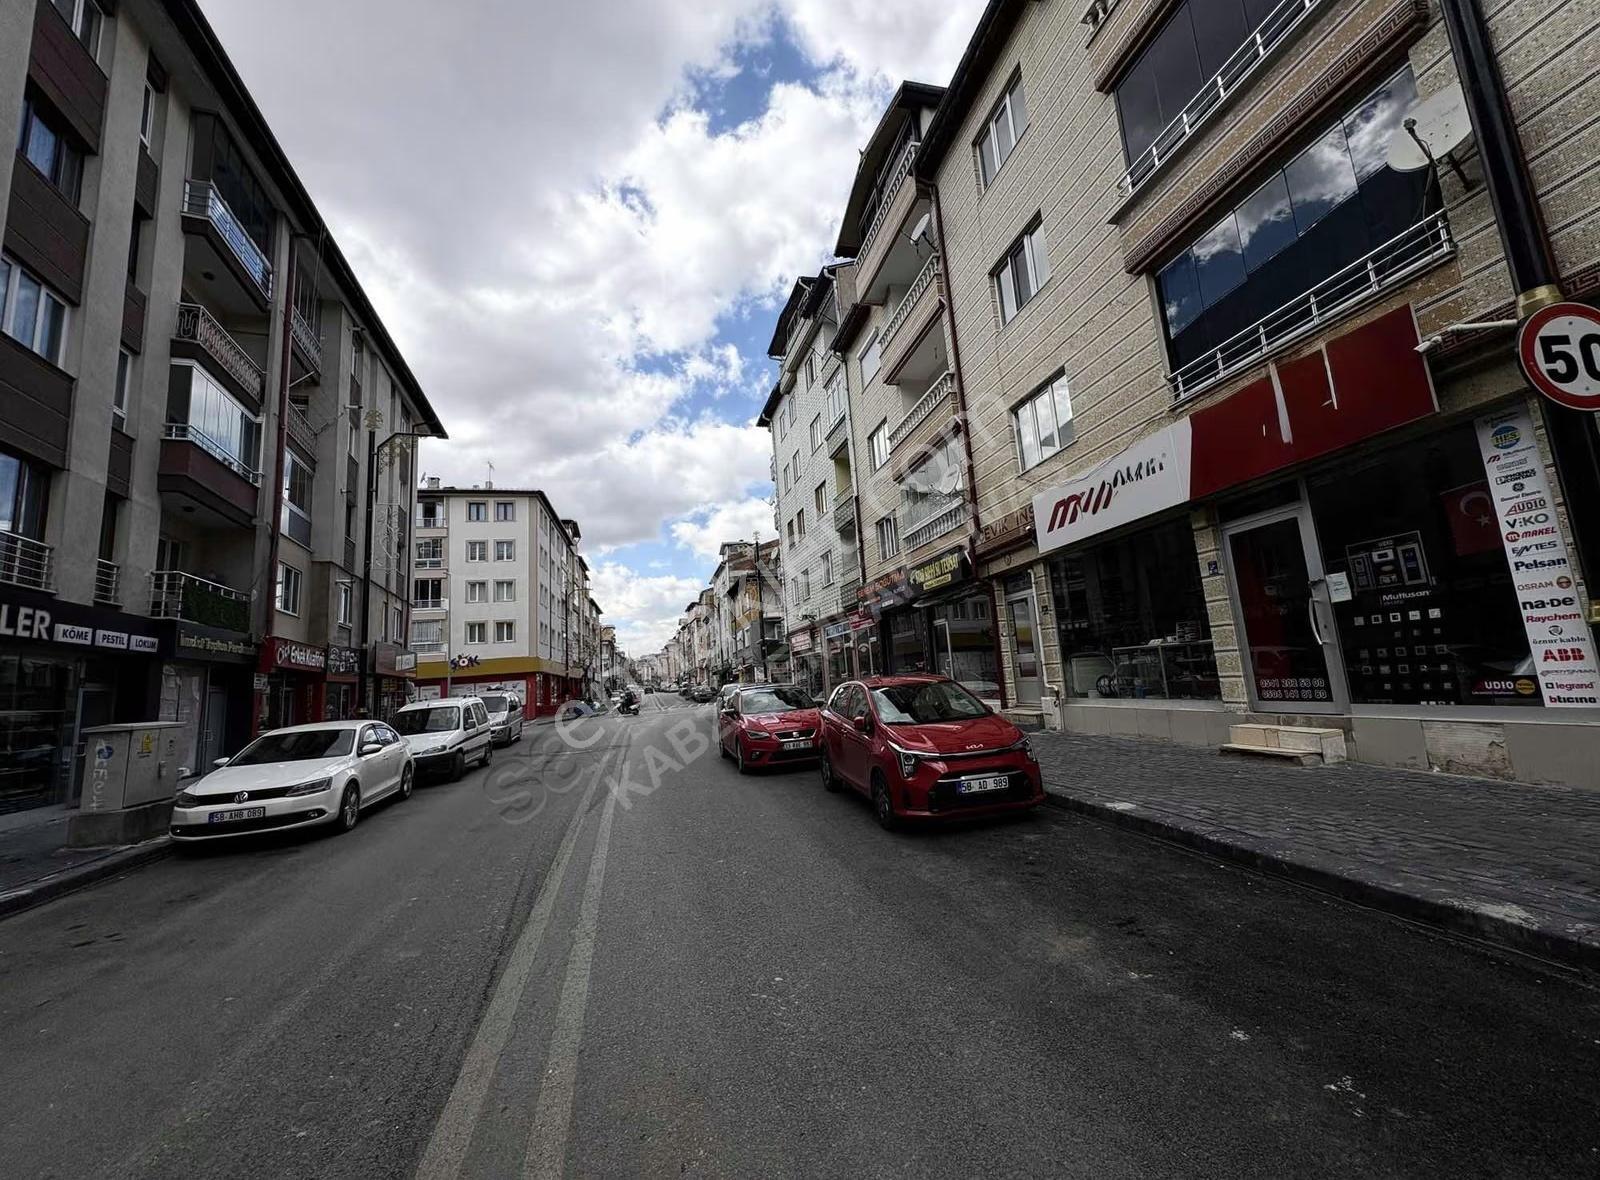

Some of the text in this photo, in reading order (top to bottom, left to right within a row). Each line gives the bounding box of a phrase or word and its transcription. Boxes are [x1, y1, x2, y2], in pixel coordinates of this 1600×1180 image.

[1539, 333, 1600, 384] 50
[1504, 498, 1547, 517] AUDIO
[1522, 526, 1558, 538] MAKEL
[1514, 557, 1567, 571] Pelsan
[1517, 580, 1554, 591] OSRAM
[0, 603, 51, 641] LER
[1525, 613, 1582, 623] Raychem
[62, 626, 89, 641] KÖME
[101, 633, 125, 646] PESTİL
[135, 638, 157, 650] LOKUM
[1542, 648, 1585, 662] ABB
[1556, 682, 1595, 691] legrand
[1549, 695, 1597, 704] bticino
[961, 782, 973, 792] 58
[214, 808, 262, 822] 58 AHB 089
